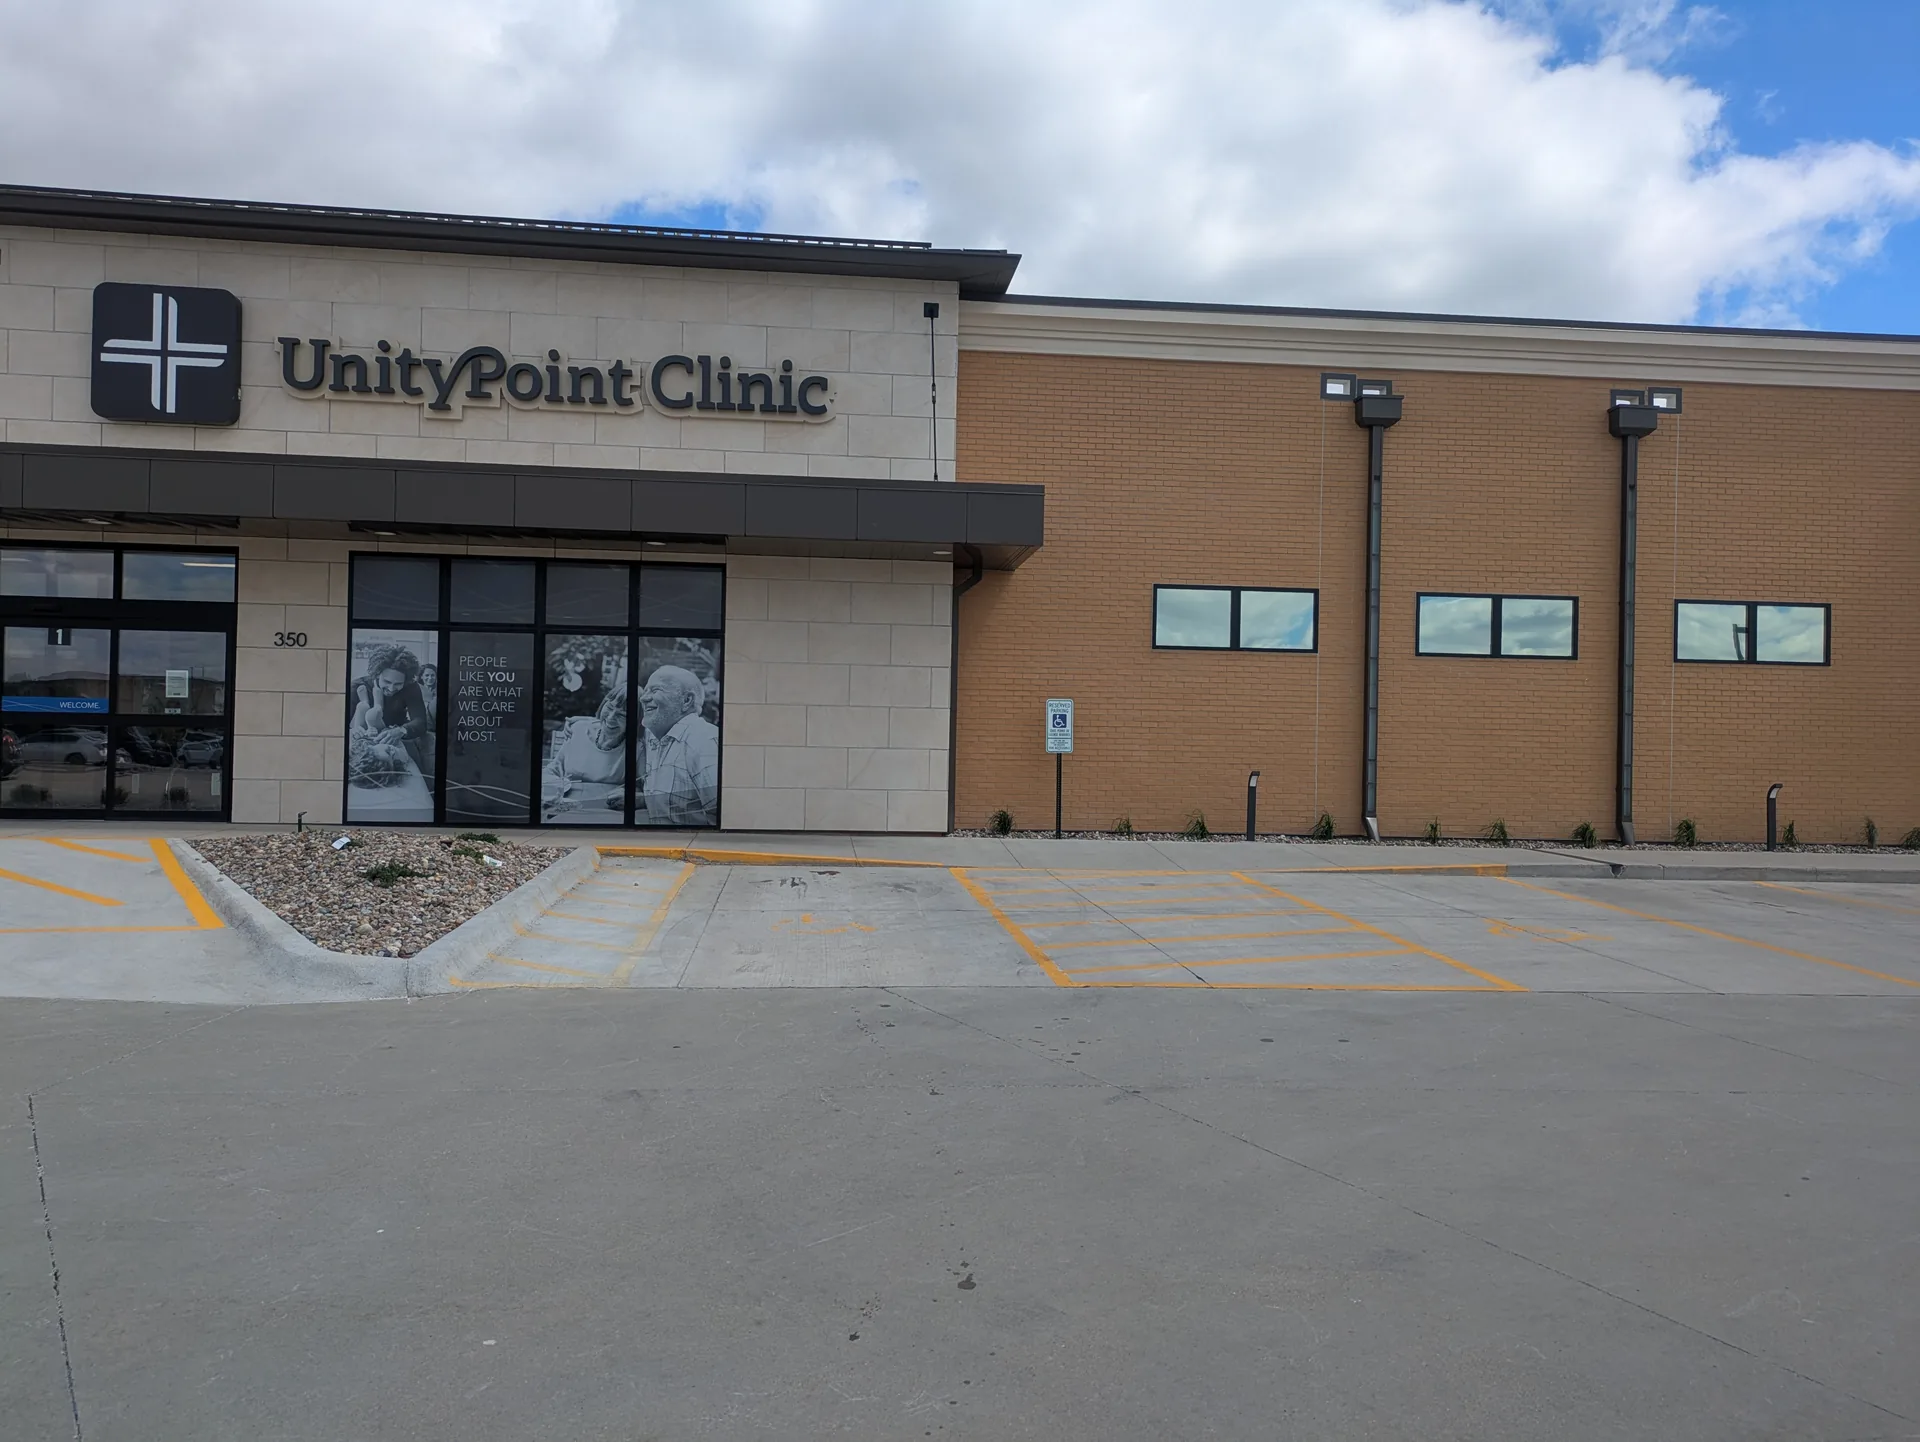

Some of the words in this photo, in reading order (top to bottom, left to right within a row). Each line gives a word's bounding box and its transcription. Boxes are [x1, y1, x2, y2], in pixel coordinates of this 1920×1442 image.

[277, 336, 635, 411] UnityPoint
[651, 354, 829, 415] Clinic
[56, 629, 63, 645] 1
[274, 631, 307, 647] 350
[459, 655, 507, 668] PEOPLE
[459, 671, 485, 682] LIKE
[487, 671, 515, 682] YOU
[458, 685, 483, 697] ARE
[485, 686, 523, 698] WHAT
[457, 700, 479, 712] WE
[481, 701, 516, 713] CARE
[457, 715, 503, 727] ABOUT
[457, 730, 497, 742] MOST.
